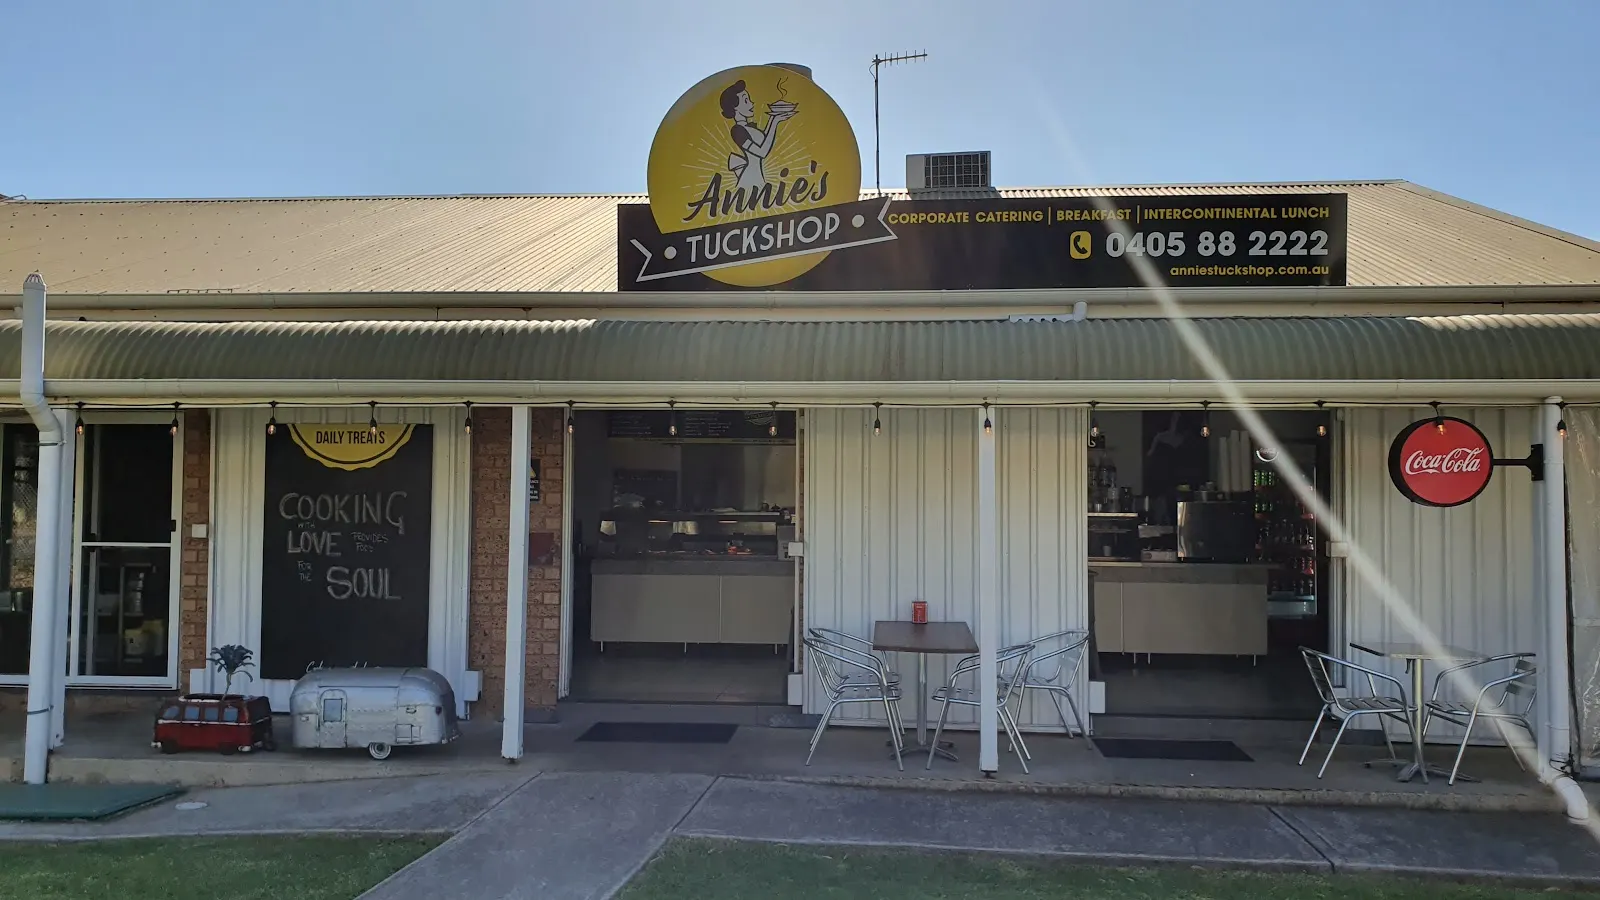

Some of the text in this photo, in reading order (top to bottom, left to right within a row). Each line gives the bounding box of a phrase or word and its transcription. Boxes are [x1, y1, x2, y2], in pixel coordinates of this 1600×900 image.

[683, 160, 829, 222] Annie's
[888, 206, 1329, 224] CORPORATE CATERING BREAKFAST INTERCONTINENTAL LUNCH
[686, 212, 840, 262] TUCKSHOP
[1105, 230, 1329, 257] 0405 88 2222
[1170, 264, 1329, 277] anniestuckshop.com.au
[316, 430, 345, 444] DAILY
[1405, 447, 1484, 475] Coca-Cola
[279, 491, 407, 535] COOKING
[287, 530, 342, 556] LOVE
[297, 560, 312, 571] FOR
[326, 565, 402, 600] SOUL
